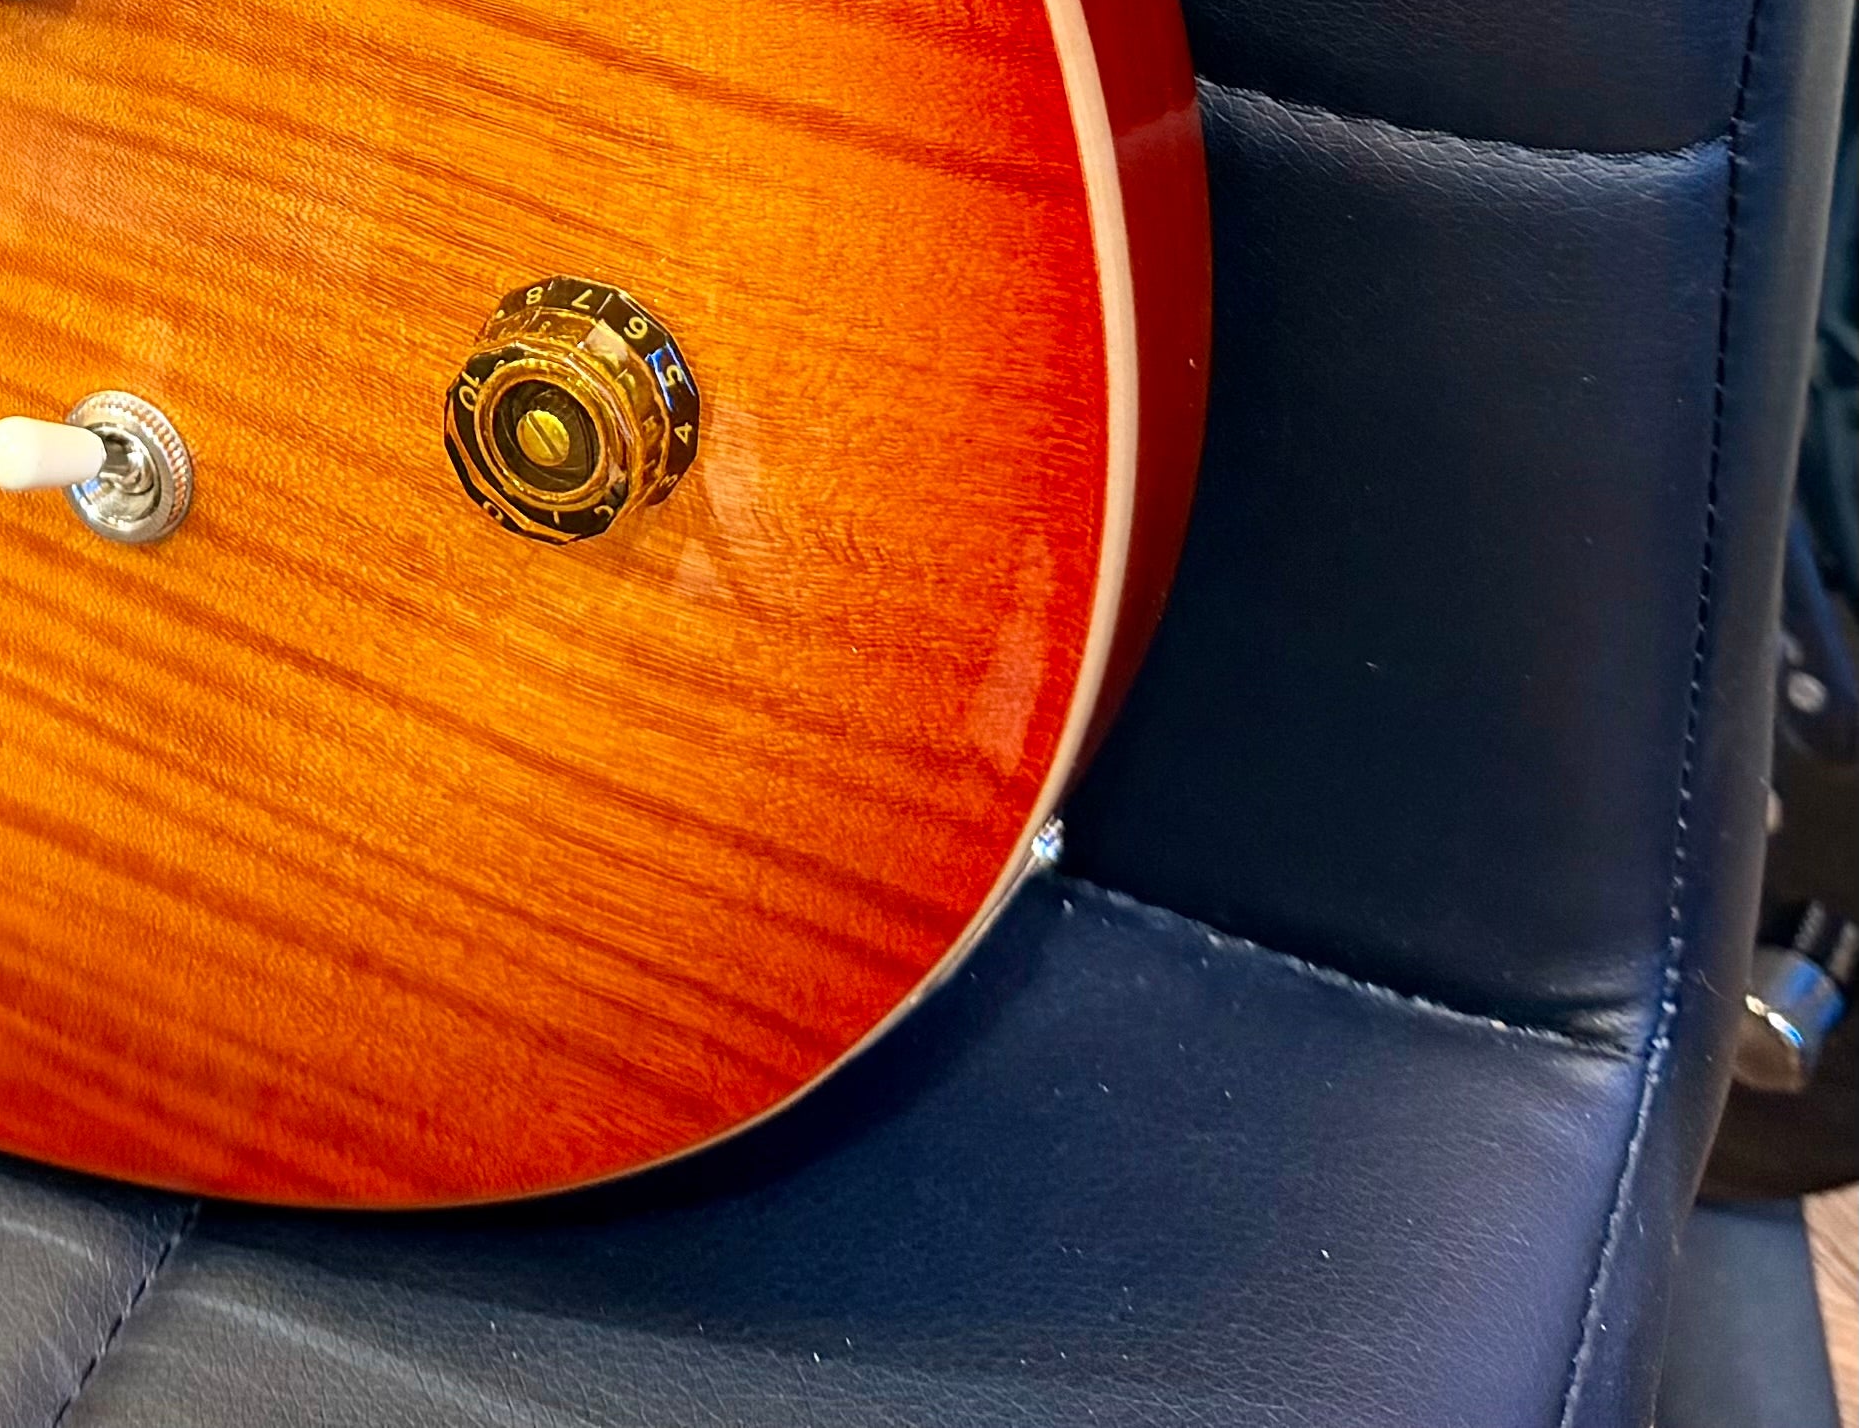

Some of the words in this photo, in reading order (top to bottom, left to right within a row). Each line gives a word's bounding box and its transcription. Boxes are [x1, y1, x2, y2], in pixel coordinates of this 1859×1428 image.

[525, 285, 544, 305] 8
[571, 289, 593, 310] 7
[663, 364, 684, 388] 5
[673, 421, 693, 445] 4
